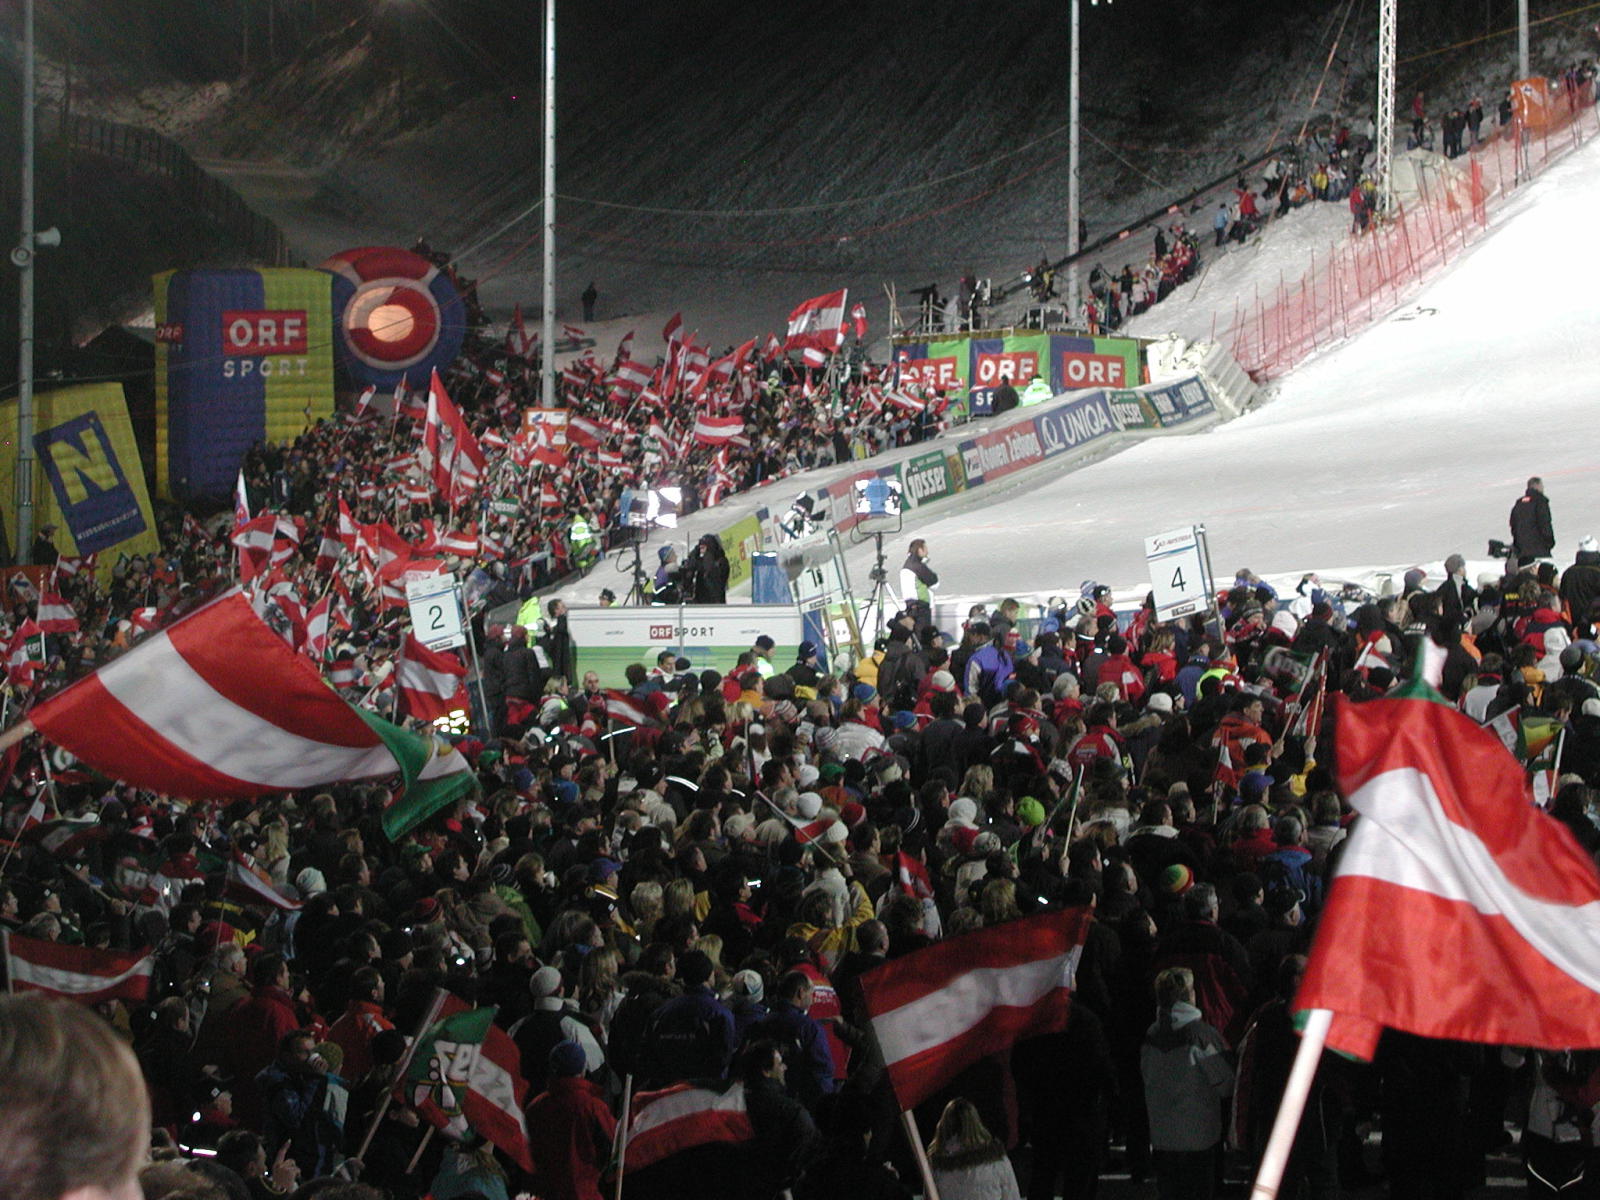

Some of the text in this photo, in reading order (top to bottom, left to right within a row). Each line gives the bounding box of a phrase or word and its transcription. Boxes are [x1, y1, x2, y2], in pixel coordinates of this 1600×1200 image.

[229, 318, 301, 348] ORF
[223, 359, 308, 378] SPORT
[979, 357, 1034, 382] ORF
[1068, 359, 1121, 383] ORF
[1060, 401, 1112, 446] UNIQA
[48, 427, 119, 506] N
[902, 458, 947, 509] Gösser
[1171, 566, 1187, 592] 4
[429, 605, 445, 631] 2
[650, 626, 715, 639] ORF SPORT
